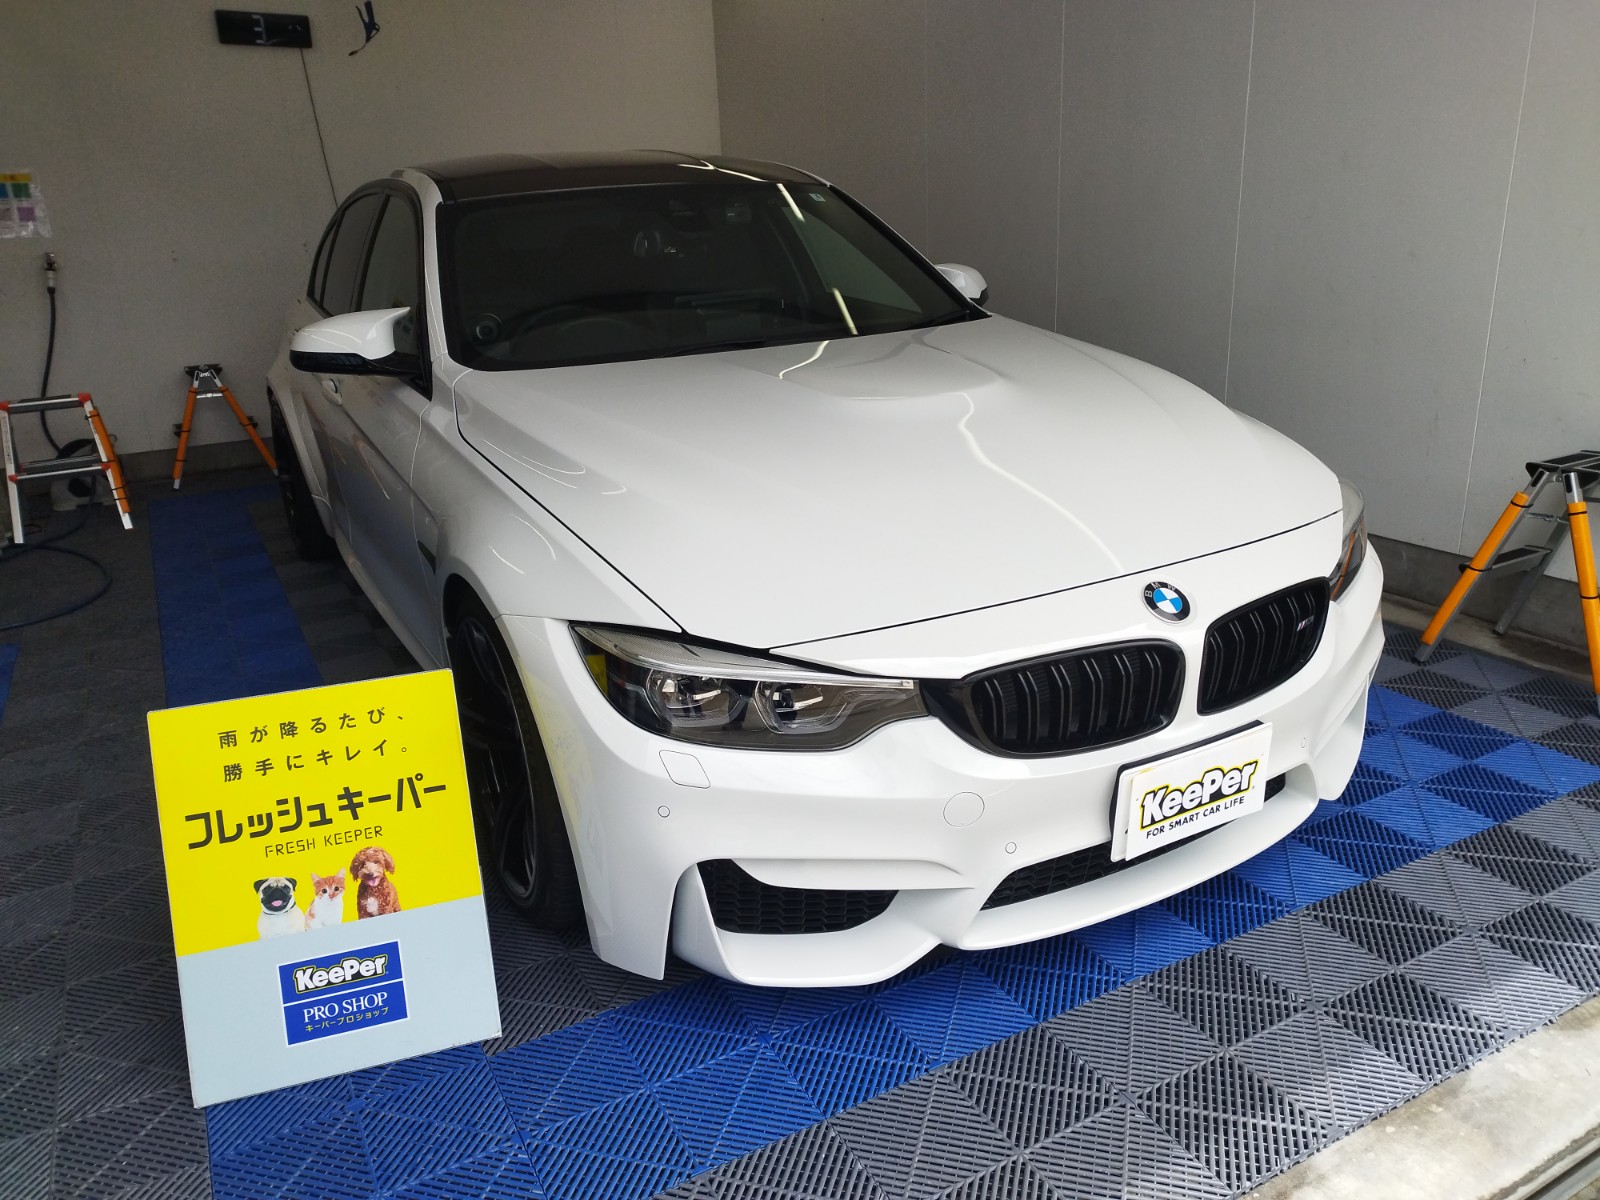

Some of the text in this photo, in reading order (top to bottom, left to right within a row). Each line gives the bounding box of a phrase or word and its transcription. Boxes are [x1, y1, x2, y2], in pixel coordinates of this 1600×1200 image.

[184, 772, 447, 850] フレッシュキーパー
[1140, 760, 1258, 830] KeePer
[1146, 796, 1245, 839] FOR SMART CAR LIFE
[264, 825, 384, 859] FRESH KEEPER
[293, 954, 388, 994] KeePer
[303, 991, 388, 1023] PRO SHOP
